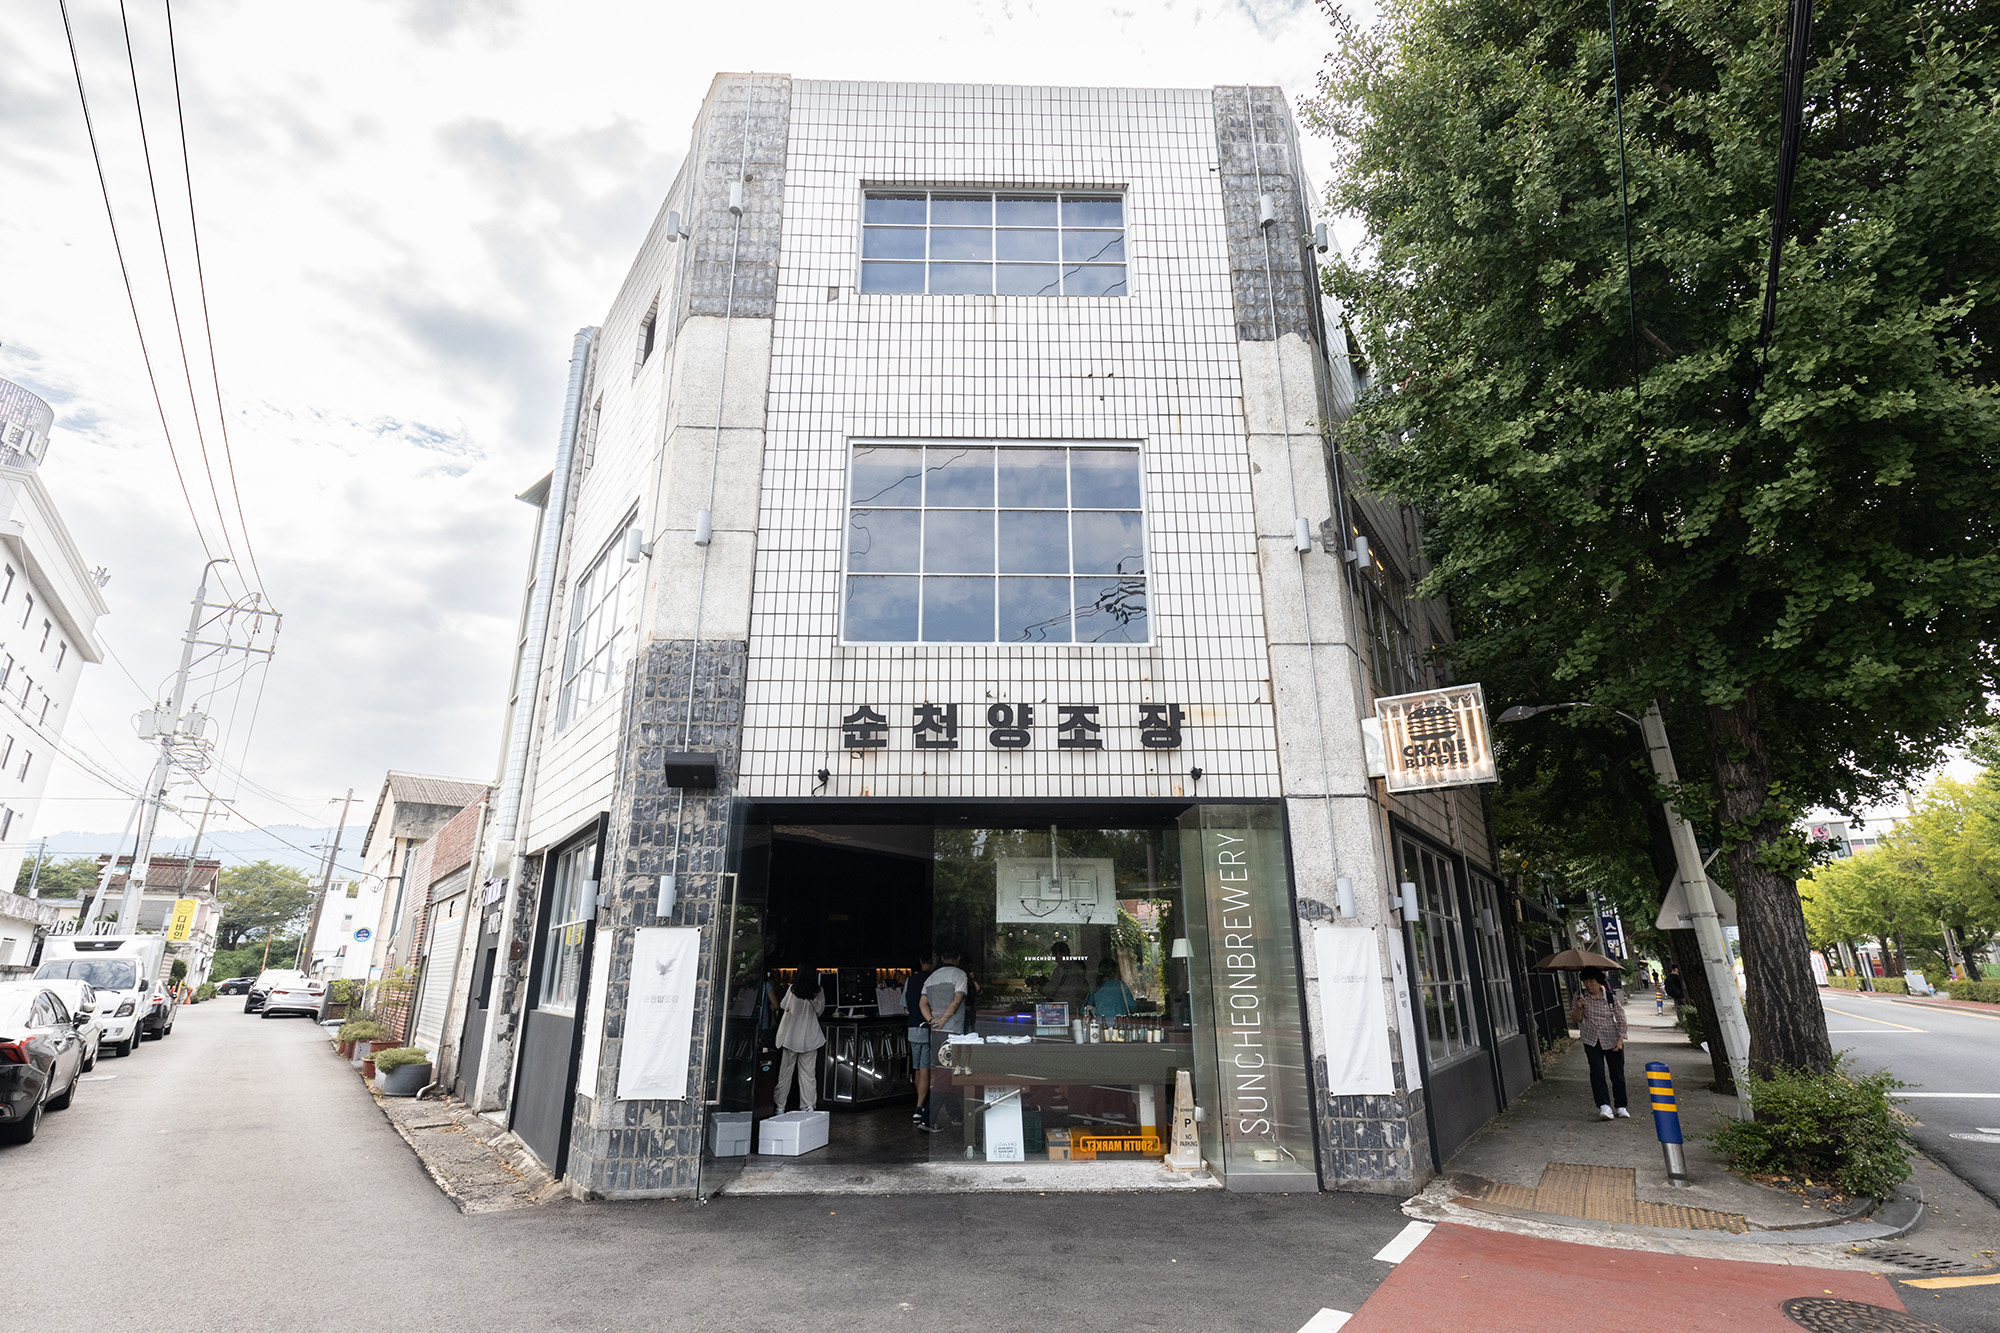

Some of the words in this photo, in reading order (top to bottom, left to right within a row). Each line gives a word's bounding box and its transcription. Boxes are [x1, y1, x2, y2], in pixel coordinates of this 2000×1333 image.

[842, 702, 1186, 749] 순천양조장
[1403, 738, 1467, 757] CRANE
[1405, 751, 1469, 769] BURGER
[173, 915, 187, 940] 디바인
[1217, 833, 1270, 1134] SUNCHEONBREWERY
[1184, 1118, 1191, 1128] P
